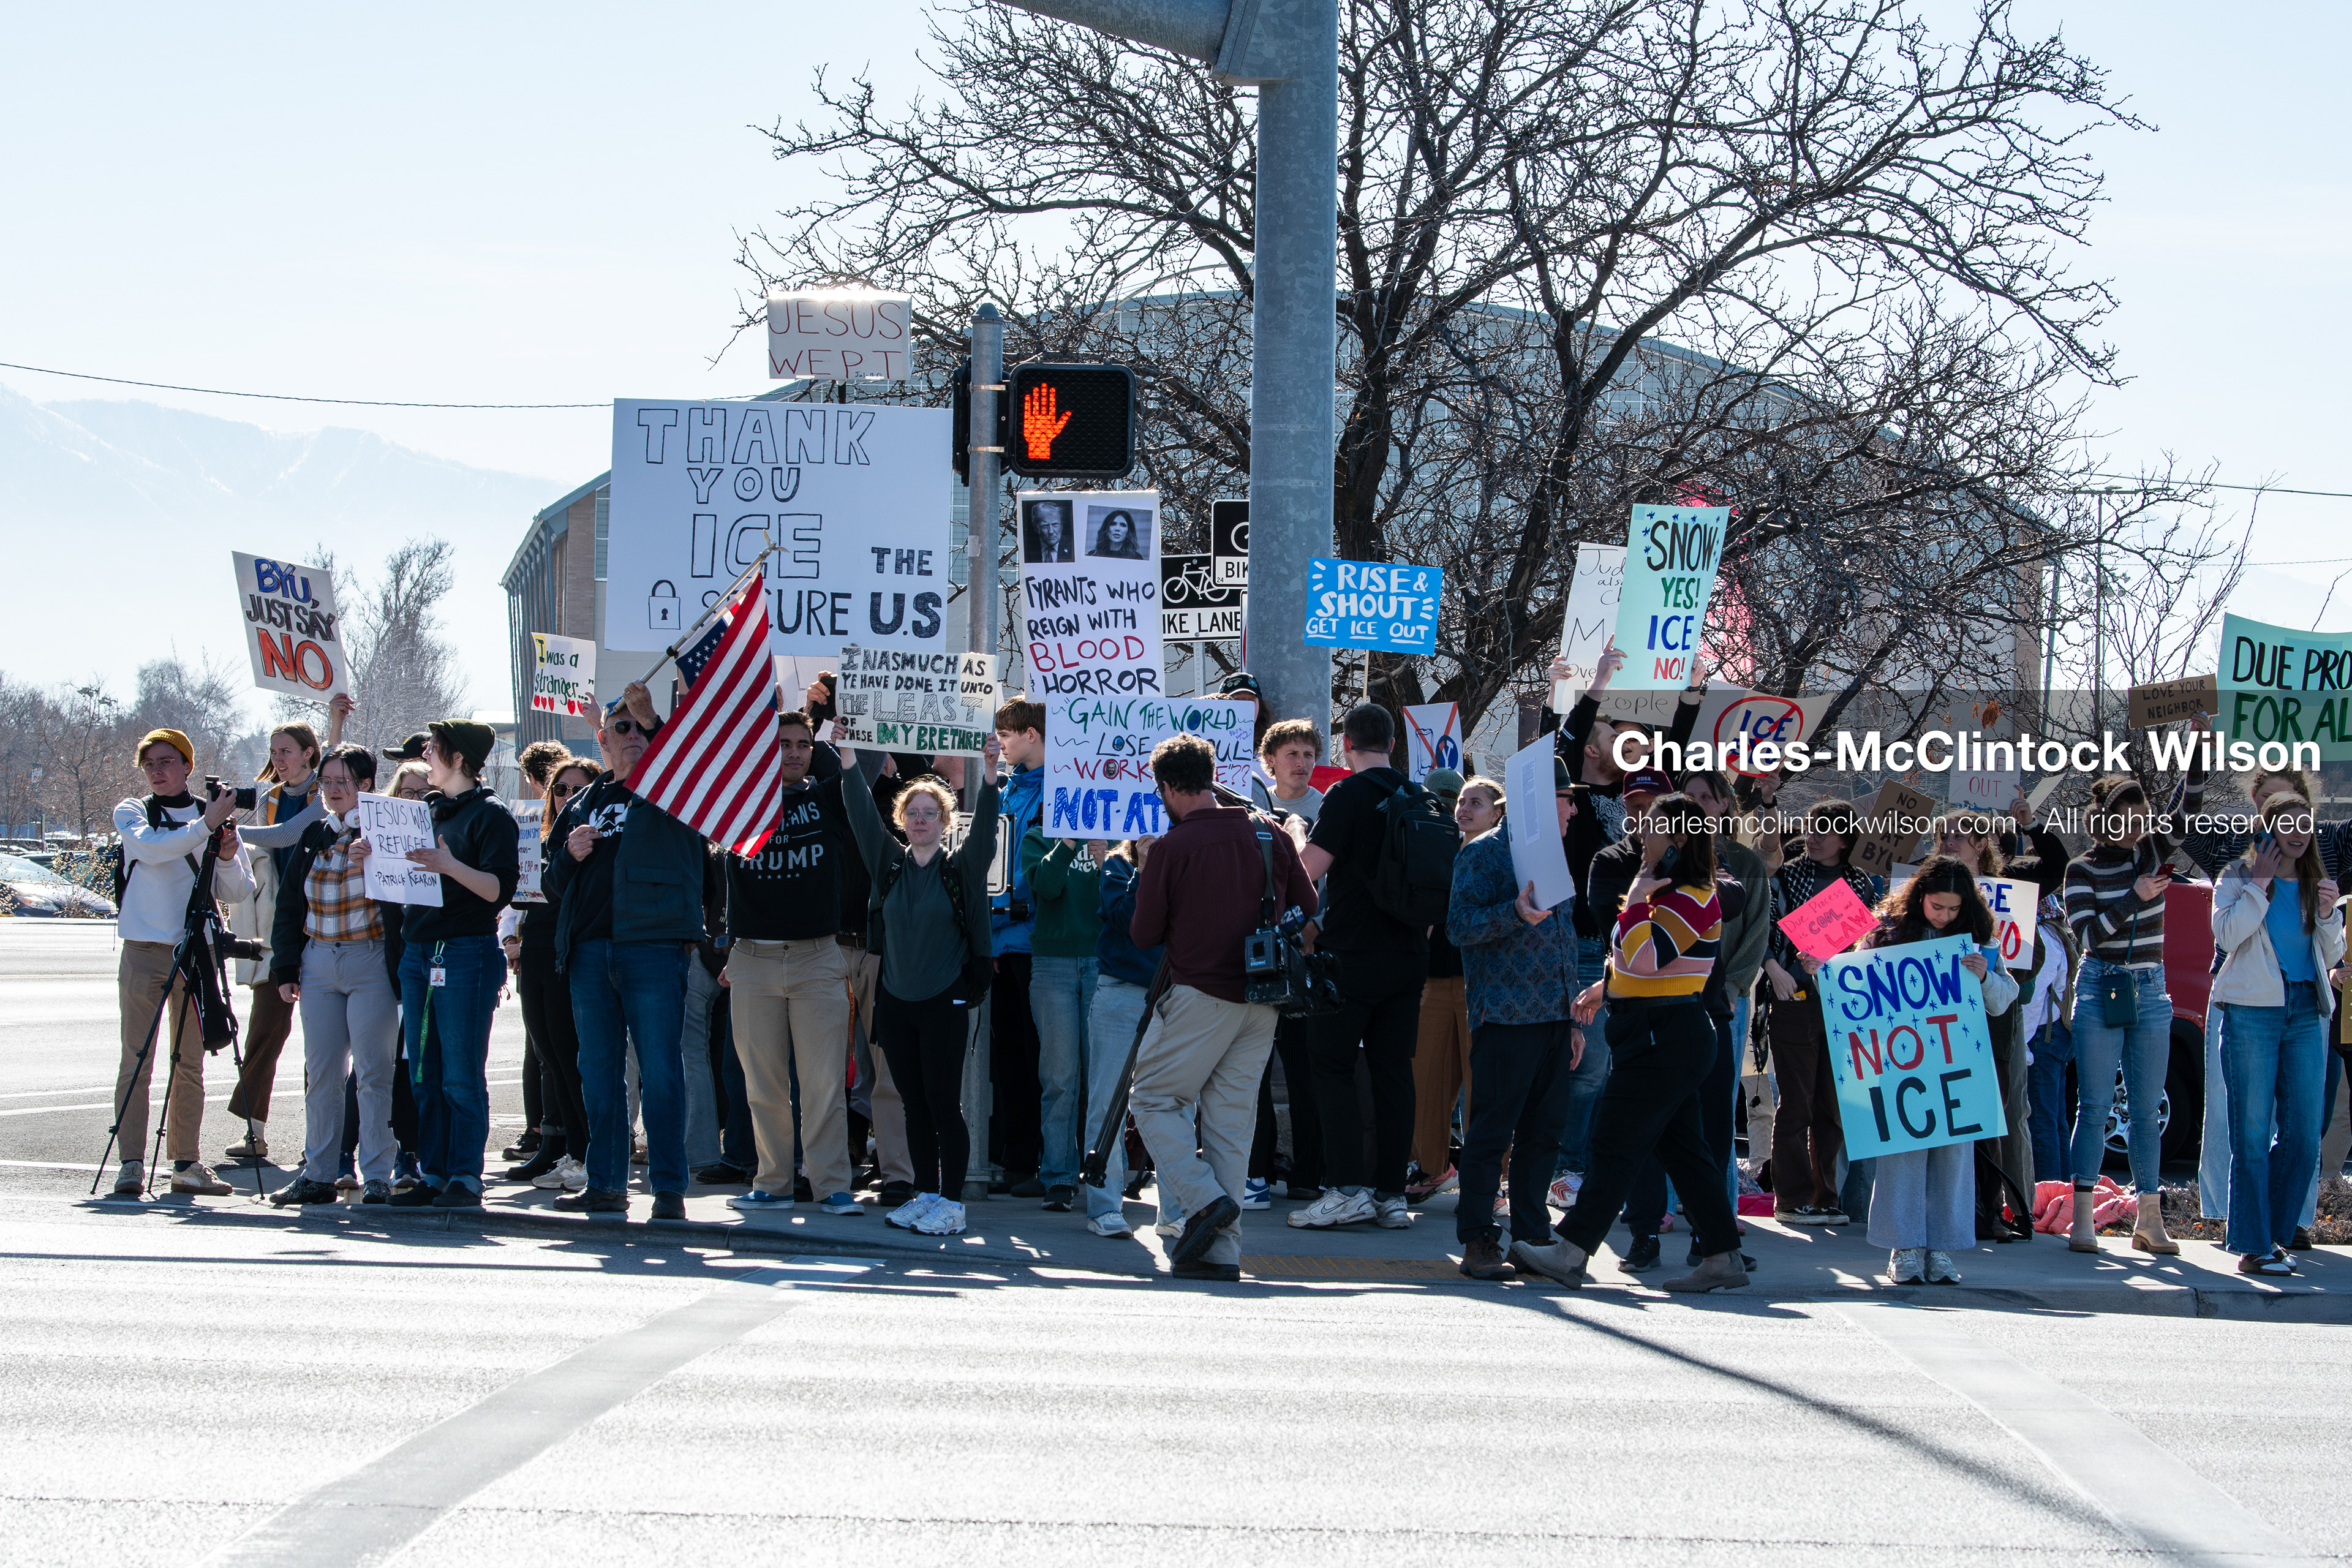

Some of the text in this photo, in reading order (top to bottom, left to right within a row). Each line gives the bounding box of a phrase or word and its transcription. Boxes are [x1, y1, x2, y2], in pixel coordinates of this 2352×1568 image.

[769, 300, 903, 339] JESUS
[769, 349, 902, 379] WEPT
[638, 408, 875, 465] THANK
[687, 467, 801, 504] YOU
[691, 513, 822, 579] ICE
[1647, 520, 1718, 571] SNOW
[870, 546, 933, 576] THE
[1580, 549, 1626, 576] Jud
[254, 558, 320, 609] BYU,
[1025, 575, 1156, 611] TYRANTS WHO
[1337, 564, 1428, 593] RISE &
[1597, 577, 1623, 586] als
[1661, 577, 1700, 609] YES!
[246, 594, 336, 641] JUST SAY
[701, 589, 852, 636] SURE
[1315, 591, 1420, 620] SHOUT
[1027, 608, 1137, 640] REIGN WITH
[1198, 611, 1240, 633] LANE
[1306, 617, 1429, 639] GET ICE OUT
[1647, 614, 1694, 650] ICE
[255, 626, 333, 691] NO
[536, 638, 579, 668] I was a
[841, 647, 986, 676] INASMUCH AS
[1029, 635, 1145, 673] BLOOD
[2233, 636, 2294, 690] DUE
[842, 672, 993, 695] YE HAVE DONE IT UNTO
[1043, 667, 1161, 695] HORROR
[1566, 663, 1596, 678] Ove
[1653, 657, 1684, 680] NO!
[2143, 679, 2205, 700] LOVE YOUR
[839, 691, 983, 722] THE LEAST
[840, 716, 856, 727] OF
[1139, 701, 1166, 731] THE
[1167, 704, 1237, 733] WORLD
[2147, 698, 2204, 720] NEIGHBOR
[2231, 692, 2304, 743] FOR
[876, 722, 914, 745] MY
[1740, 709, 1793, 742] ICE
[1096, 733, 1152, 758] LOSE
[1896, 792, 1917, 810] NO
[1969, 776, 2002, 797] OUT
[361, 801, 431, 835] JESUS WAS
[375, 834, 427, 854] REFUGEE
[769, 834, 789, 844] FOR
[1880, 831, 1904, 848] AT
[740, 844, 824, 870] RUMP
[407, 867, 437, 887] KEARON
[1782, 889, 1844, 933] Due Process
[1809, 908, 1844, 935] COOL
[1844, 901, 1853, 911] and
[1825, 905, 1875, 948] LAW!
[1838, 954, 1962, 1021] SNOW
[1848, 1014, 1958, 1080] NOT
[1869, 1068, 1983, 1142] ICE
